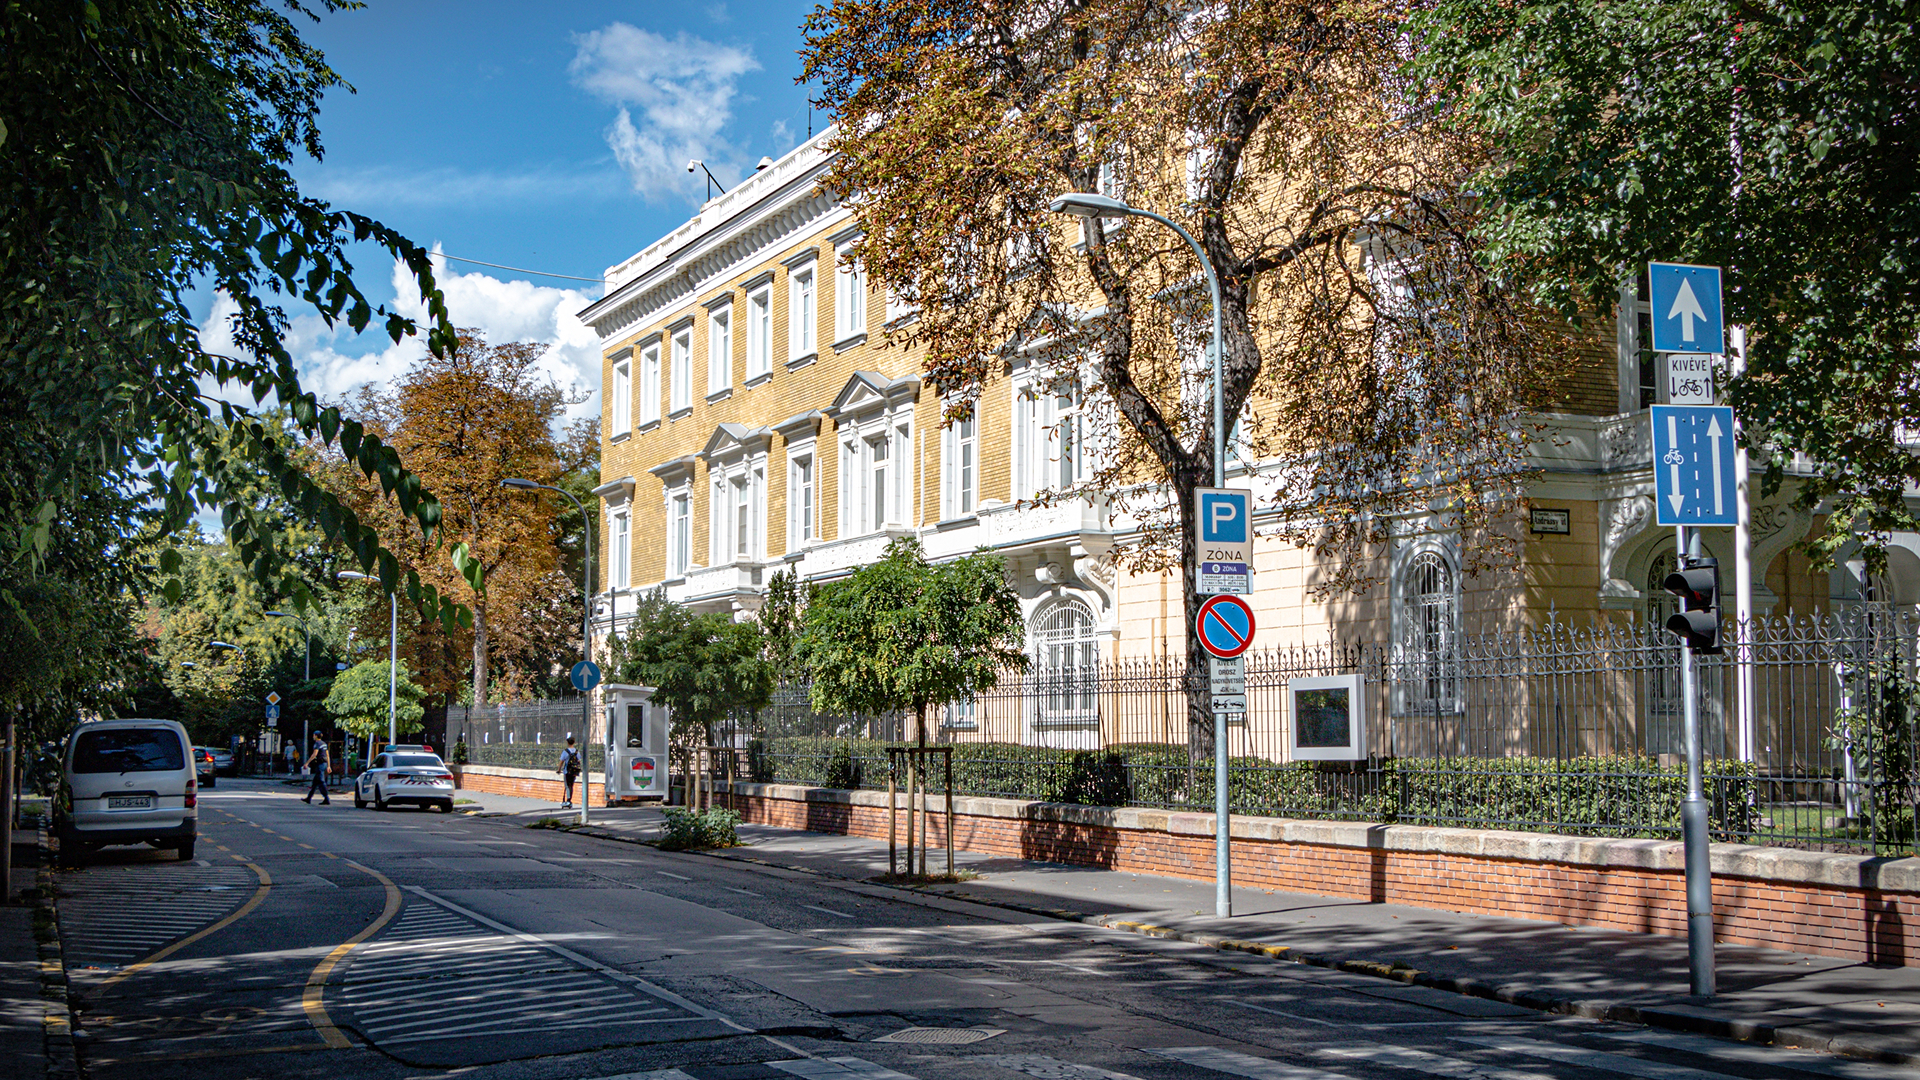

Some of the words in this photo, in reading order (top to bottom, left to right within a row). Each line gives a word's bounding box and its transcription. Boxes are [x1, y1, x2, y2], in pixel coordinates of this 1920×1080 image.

[1672, 357, 1707, 371] KIVÉVE
[1211, 502, 1237, 534] P
[1206, 547, 1243, 561] ZÓNA
